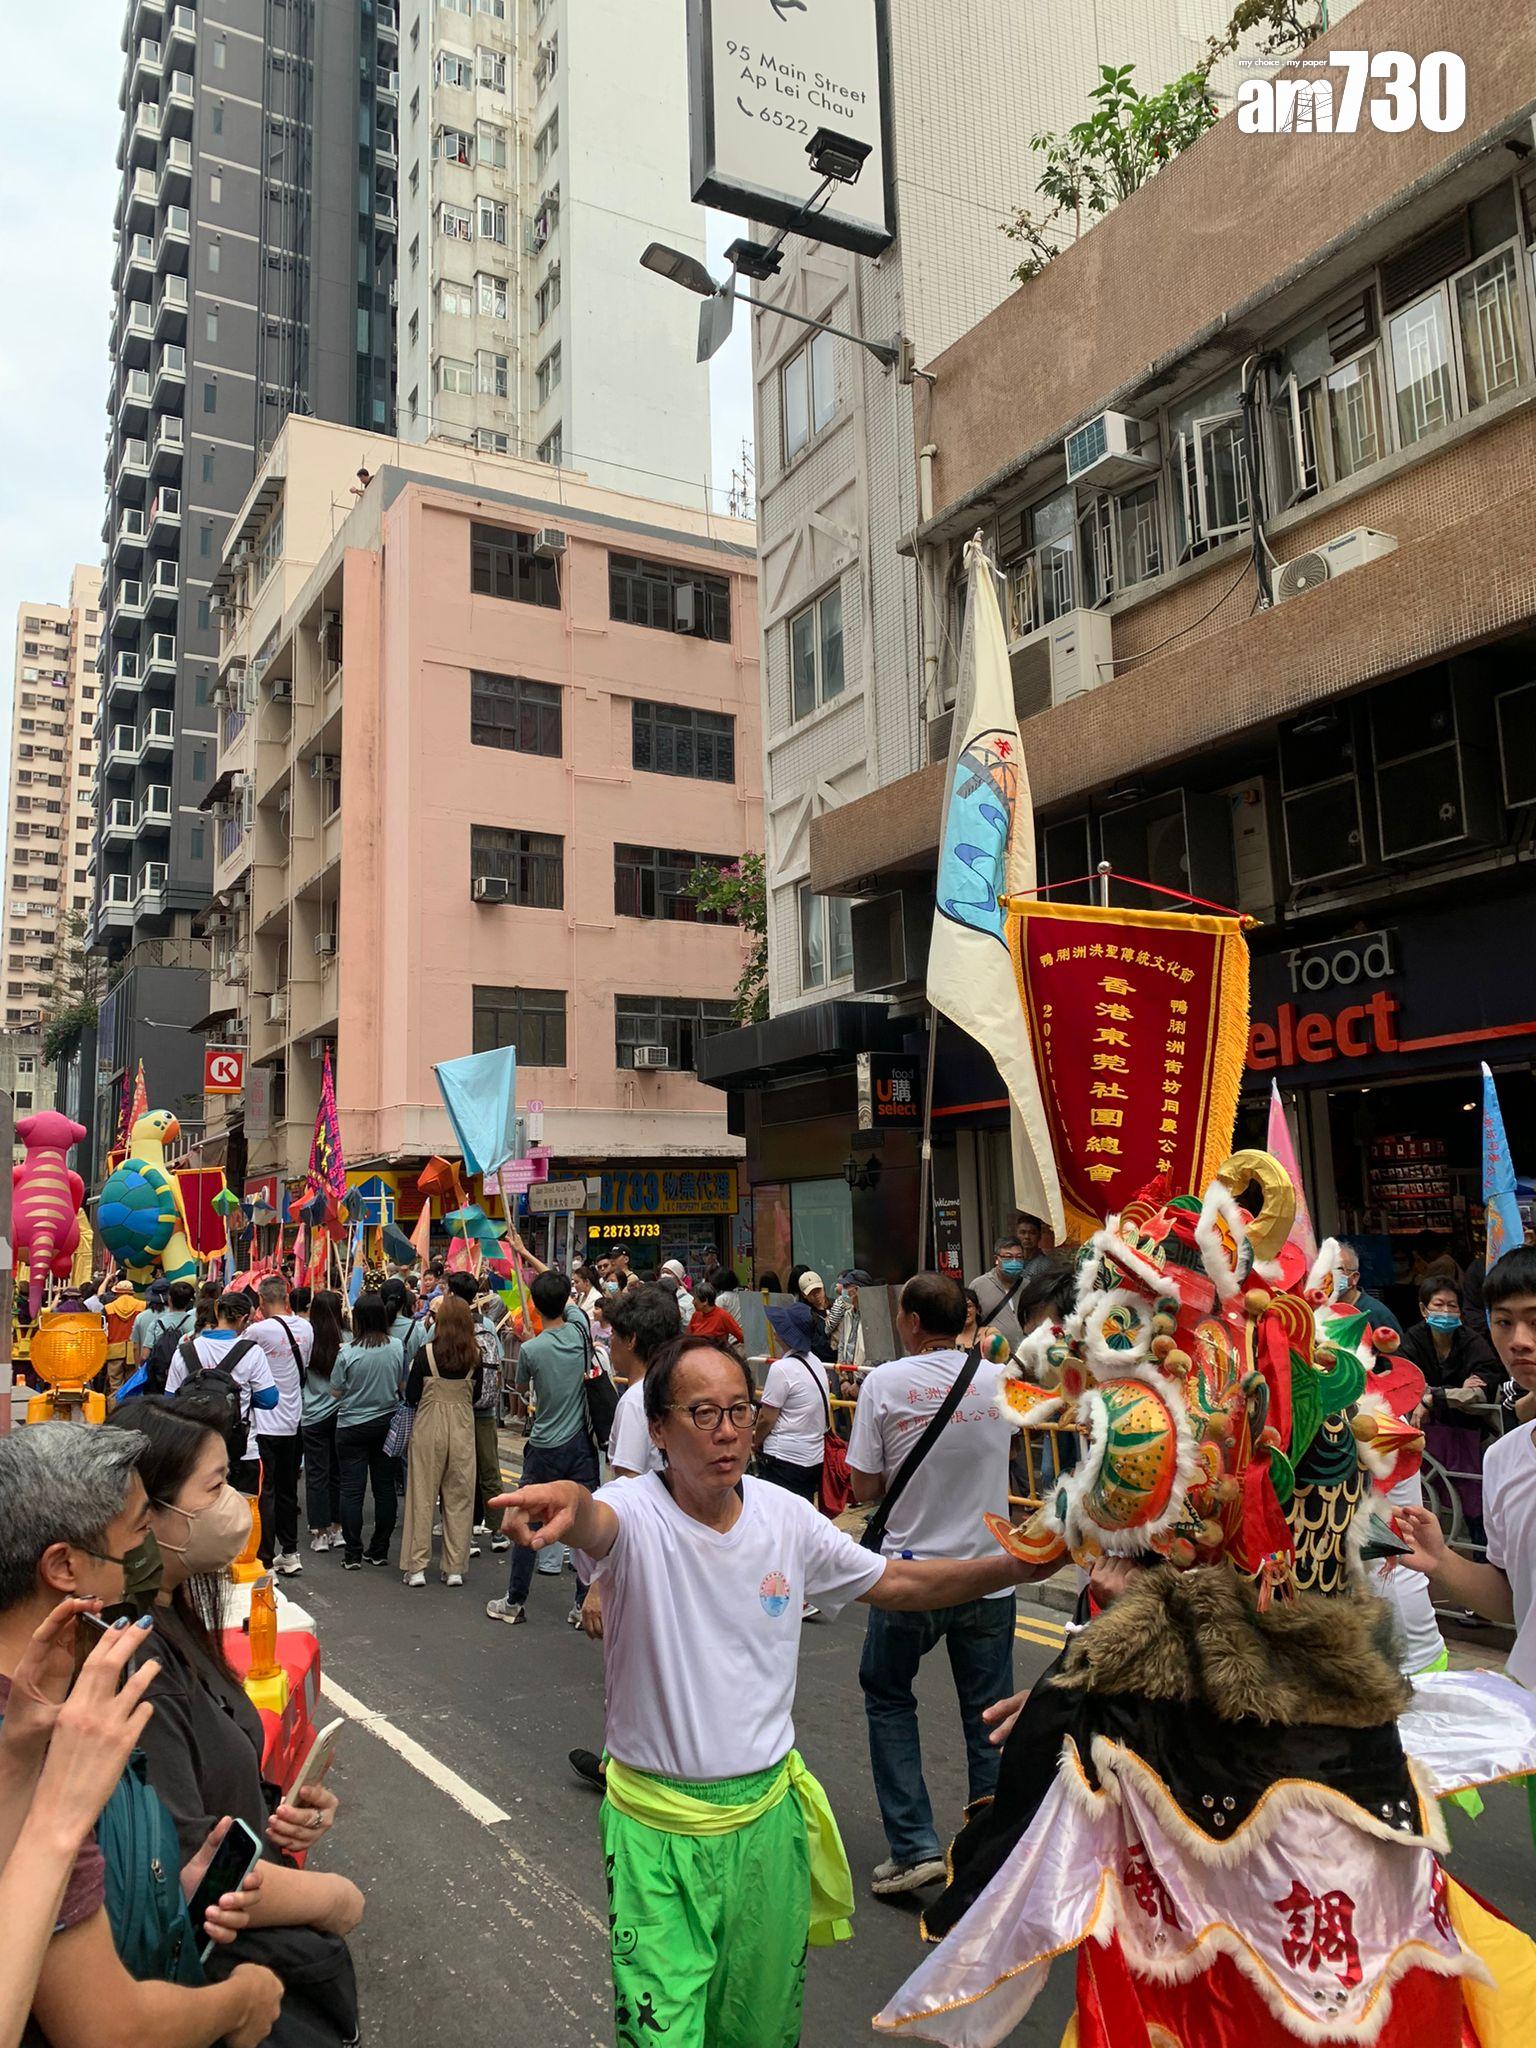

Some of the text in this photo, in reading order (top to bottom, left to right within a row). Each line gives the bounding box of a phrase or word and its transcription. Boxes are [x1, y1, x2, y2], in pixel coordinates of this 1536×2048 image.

[726, 40, 866, 104] 95 Main Street
[740, 66, 854, 118] Ap Lei Chau
[760, 107, 809, 136] 6522
[1287, 930, 1395, 993] food
[1246, 990, 1402, 1072] elect
[892, 1068, 914, 1079] food
[1083, 975, 1137, 1183] 香港東莞社團總會
[878, 1101, 916, 1116] select
[663, 1172, 730, 1200] 物業代理
[603, 1225, 631, 1238] 2873
[633, 1224, 660, 1237] 3733
